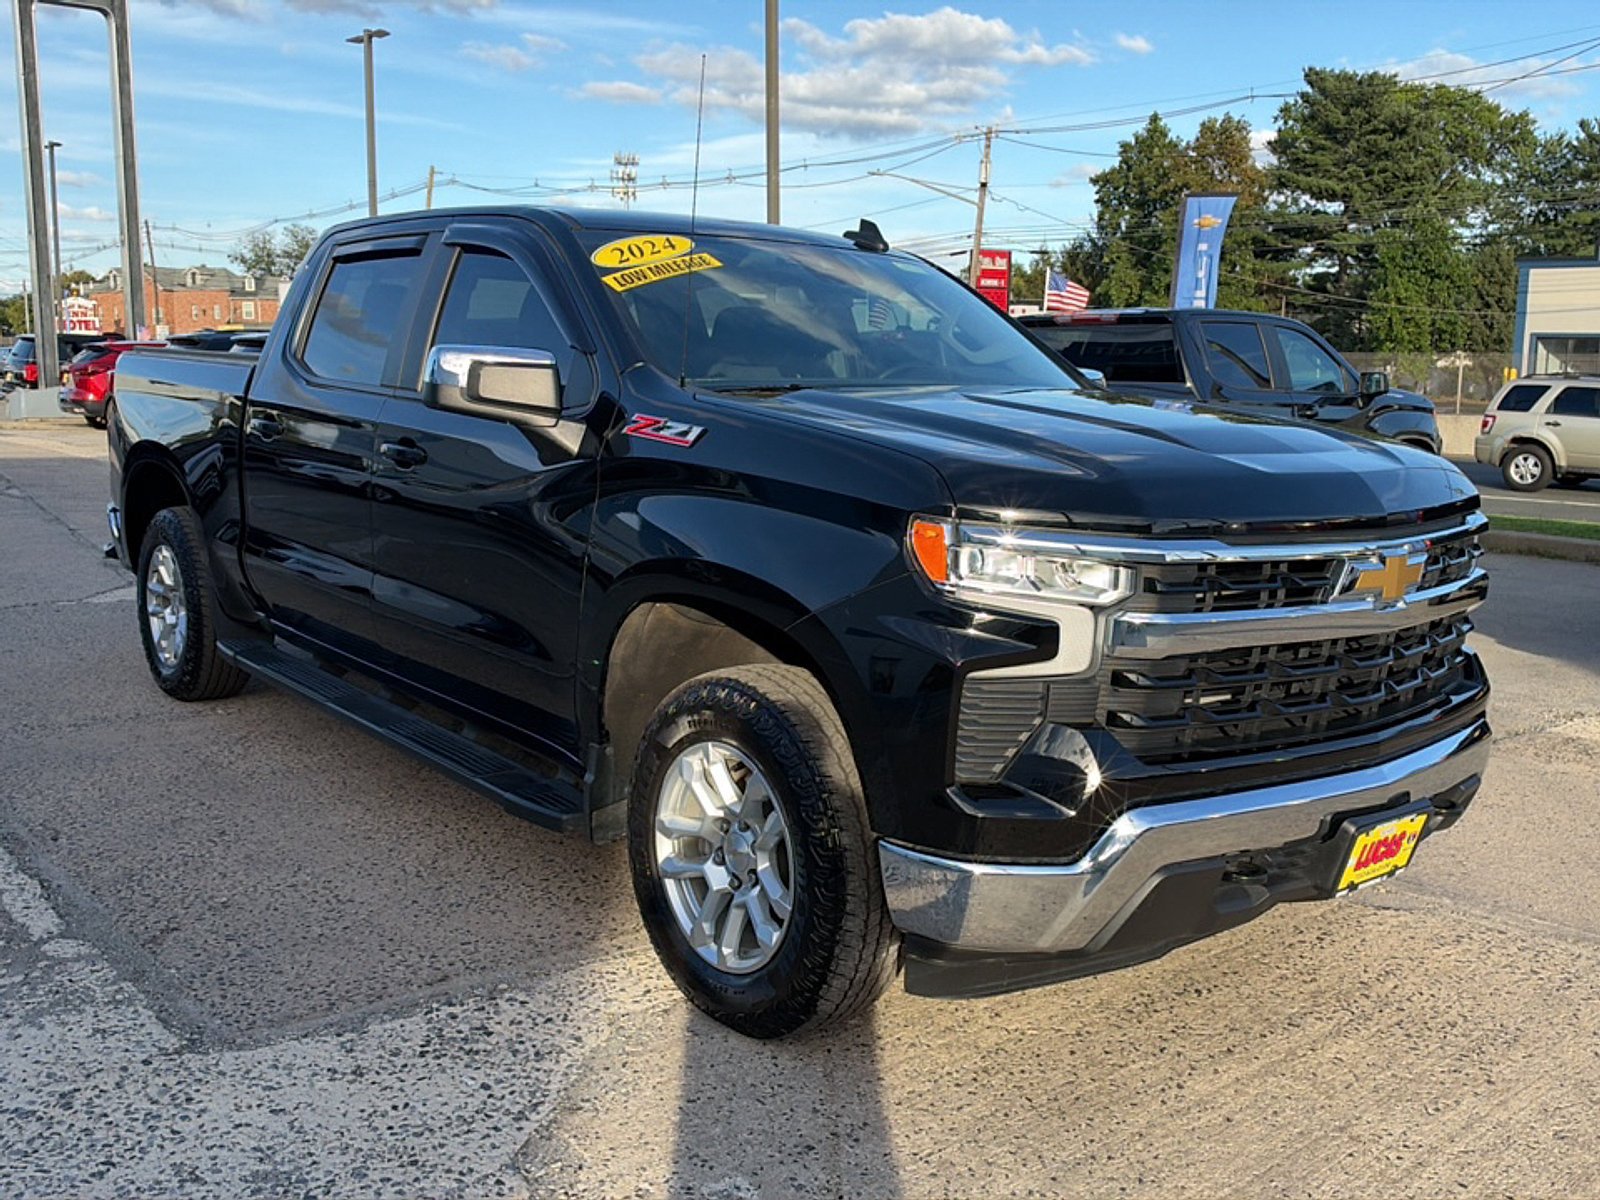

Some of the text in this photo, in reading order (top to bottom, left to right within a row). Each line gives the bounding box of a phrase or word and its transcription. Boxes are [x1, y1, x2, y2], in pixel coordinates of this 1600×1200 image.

[610, 236, 677, 265] 2024
[613, 255, 712, 288] LOW MILEAGE
[621, 413, 707, 448] Z71
[1354, 830, 1407, 871] LUCAS
